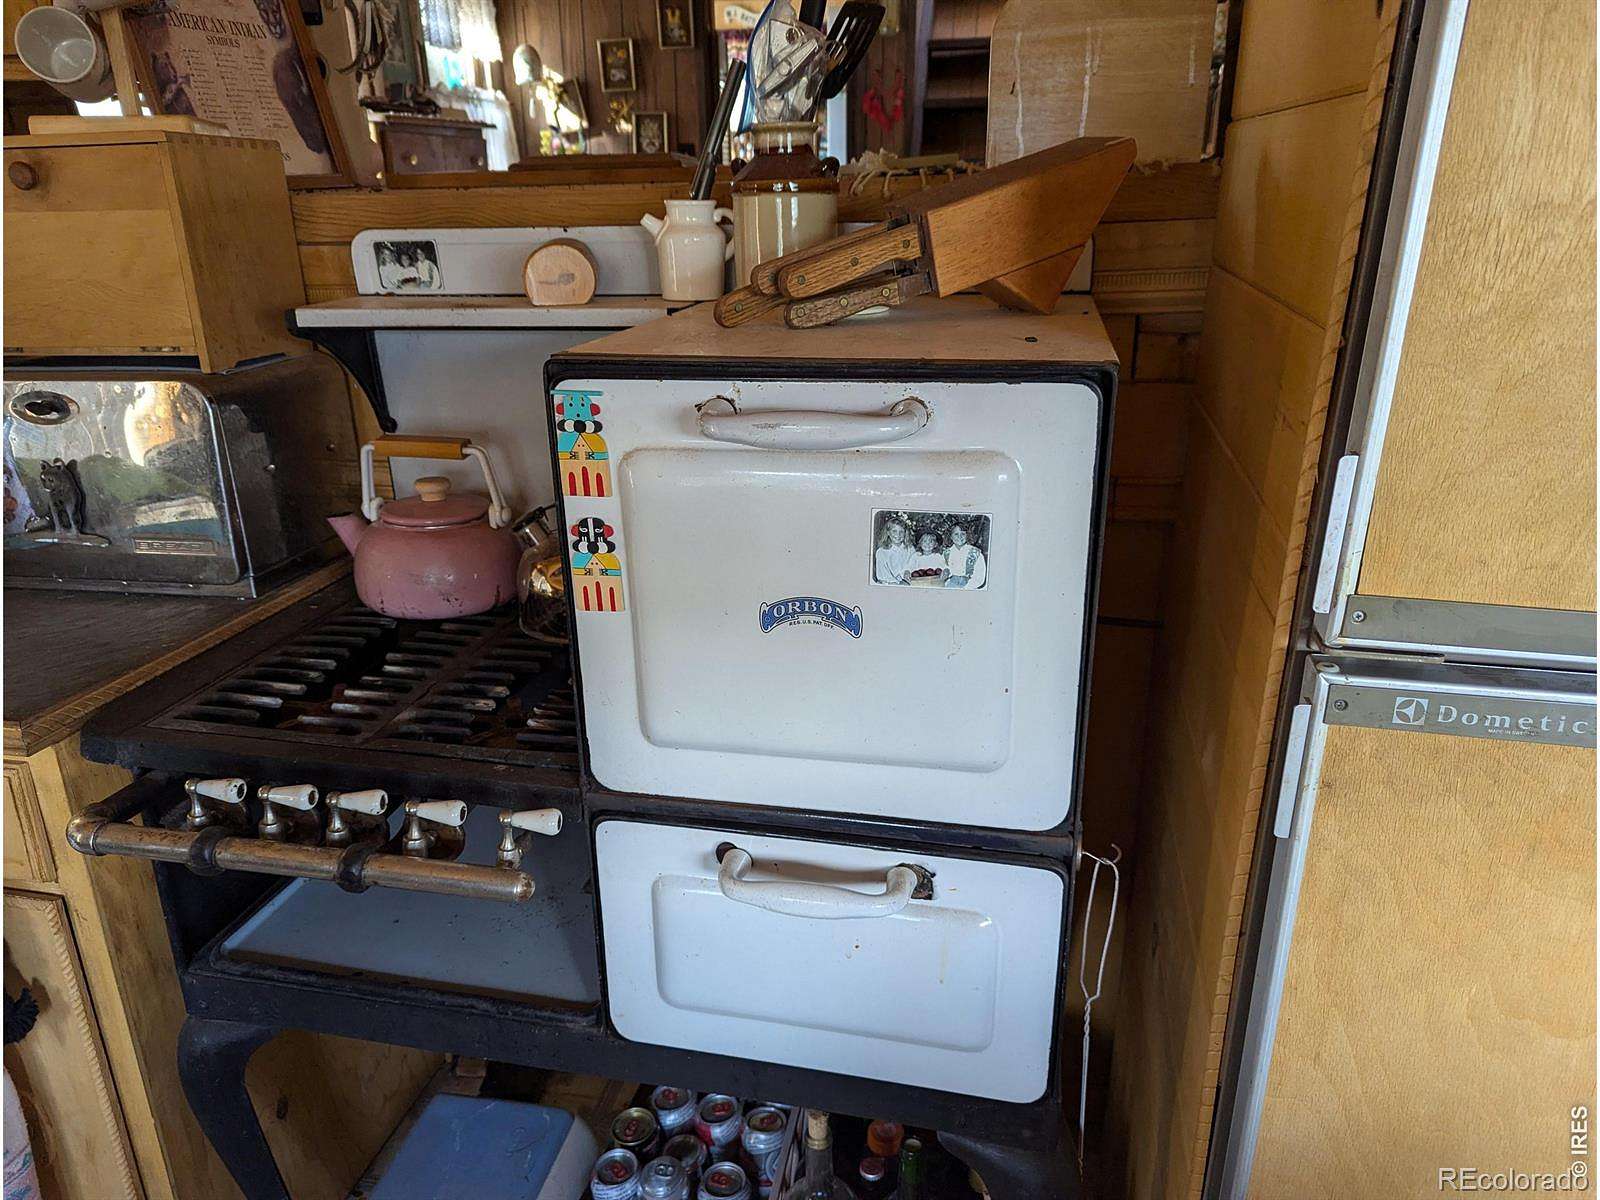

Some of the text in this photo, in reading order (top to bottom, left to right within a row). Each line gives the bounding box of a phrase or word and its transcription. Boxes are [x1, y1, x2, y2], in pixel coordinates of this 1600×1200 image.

[168, 9, 267, 39] AMERICAN INDIAN
[206, 35, 240, 48] SYMBOLS
[773, 600, 847, 622] ORBON
[1437, 705, 1589, 734] Dometic
